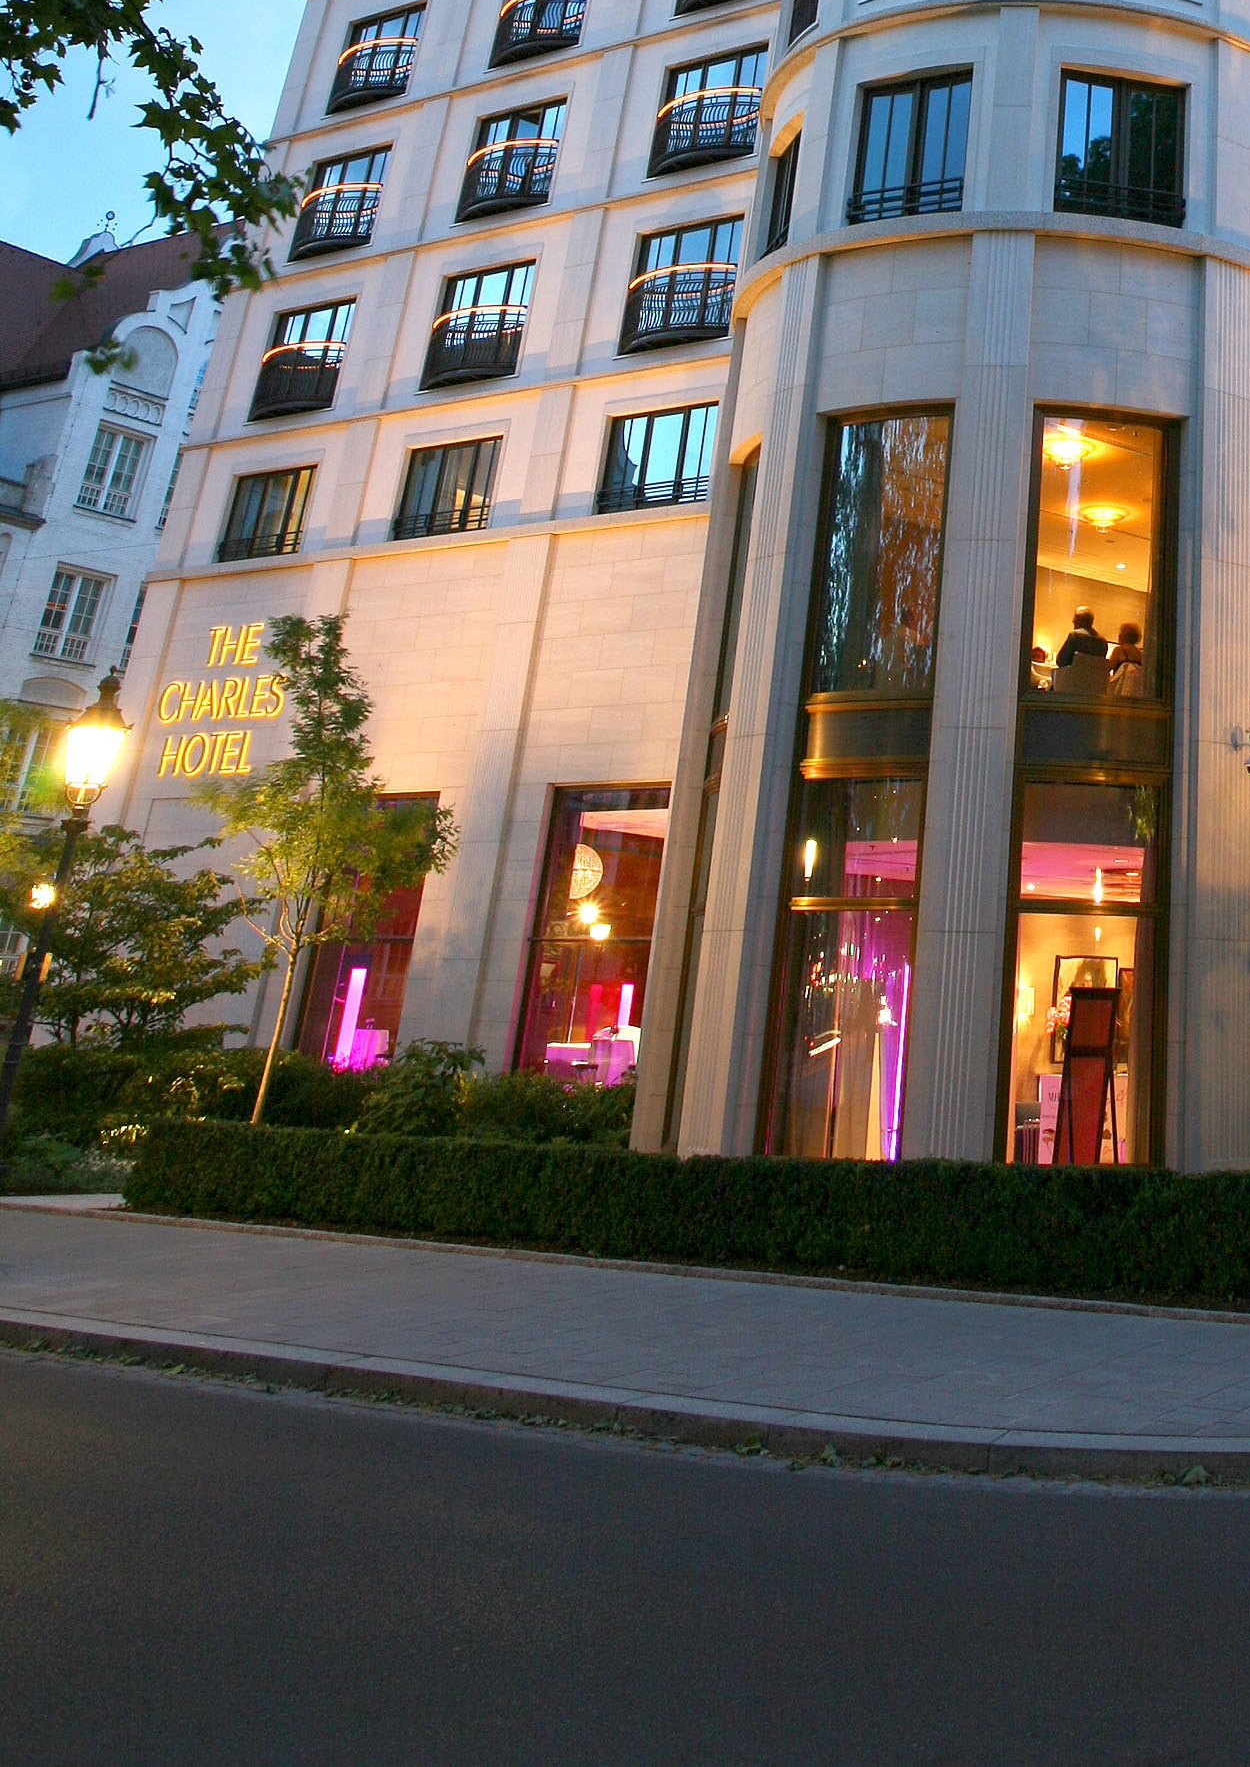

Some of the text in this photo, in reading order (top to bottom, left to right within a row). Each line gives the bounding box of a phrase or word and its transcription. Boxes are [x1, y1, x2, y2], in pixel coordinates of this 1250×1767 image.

[207, 621, 266, 667] THE
[158, 672, 289, 725] CHARLES
[157, 729, 253, 777] HOTEL
